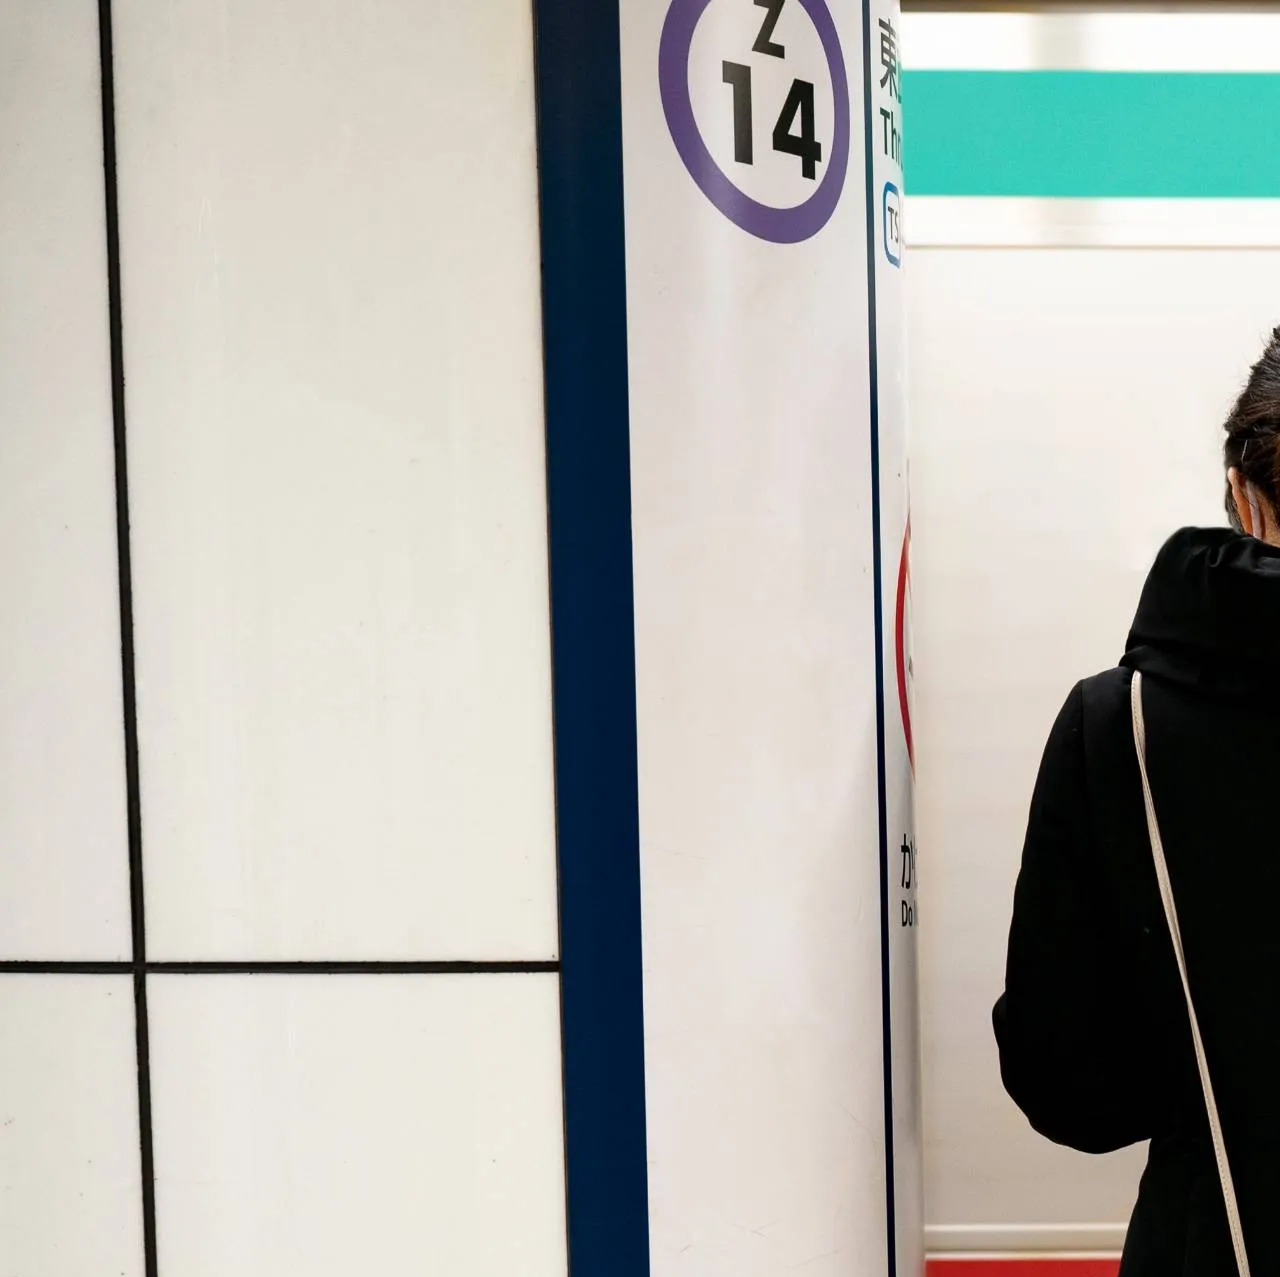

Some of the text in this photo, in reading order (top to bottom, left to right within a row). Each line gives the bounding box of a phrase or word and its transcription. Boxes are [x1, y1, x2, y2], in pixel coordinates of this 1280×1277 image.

[751, 0, 786, 59] Z
[878, 17, 902, 104] 東
[722, 60, 822, 181] 14
[879, 106, 903, 171] Thr
[887, 206, 899, 244] TS
